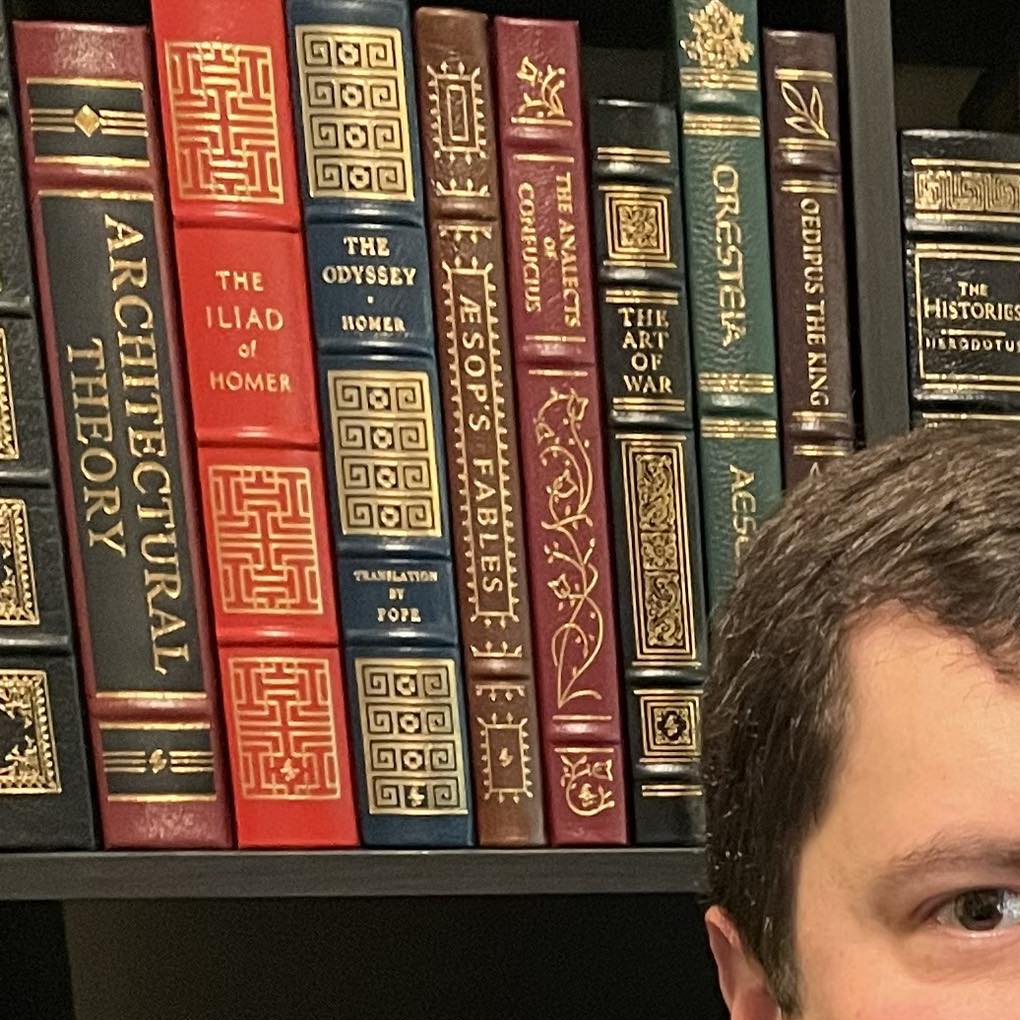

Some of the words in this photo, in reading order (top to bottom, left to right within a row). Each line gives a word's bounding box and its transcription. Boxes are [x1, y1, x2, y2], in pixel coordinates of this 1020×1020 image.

[555, 172, 573, 215] THE
[343, 237, 390, 256] THE
[518, 182, 542, 313] CONFUCIUS
[543, 236, 559, 262] OF
[800, 198, 825, 295] OEDIPUS
[215, 271, 264, 292] THE
[322, 266, 416, 286] ODYSSEY
[559, 218, 581, 328] ANALECTS
[957, 280, 989, 297] THE
[206, 305, 283, 330] ILIAD
[342, 315, 406, 333] HOMER
[618, 307, 669, 328] THE
[805, 299, 827, 346] THE
[239, 340, 257, 358] of
[622, 331, 670, 350] ART
[631, 352, 663, 371] OF
[210, 372, 292, 393] HOMER
[623, 374, 673, 394] WAR
[807, 352, 830, 406] KING
[67, 337, 126, 557] THEORY
[105, 214, 190, 675] ARCHITECTURAL
[472, 458, 503, 593] FABLES
[353, 570, 437, 582] TRANSLATION
[389, 587, 405, 600] BY
[377, 607, 421, 622] POPE
